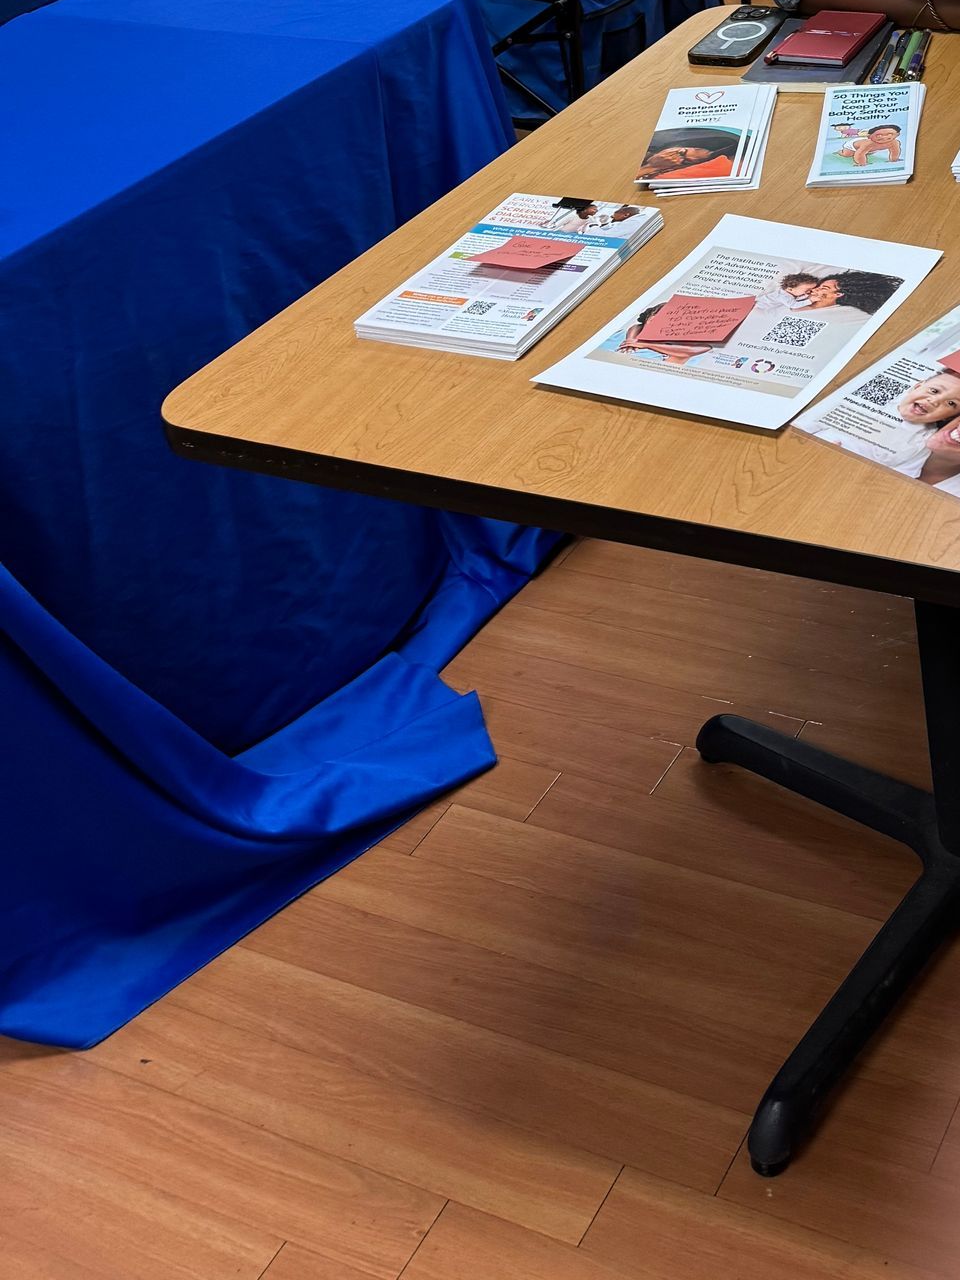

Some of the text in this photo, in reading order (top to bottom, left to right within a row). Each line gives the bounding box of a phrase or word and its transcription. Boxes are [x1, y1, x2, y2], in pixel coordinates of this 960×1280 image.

[501, 206, 555, 215] SCREENING
[732, 257, 764, 266] Institute
[715, 267, 747, 277] Minority
[748, 272, 774, 280] Health
[724, 262, 780, 275] Advancement
[693, 275, 722, 284] Project
[699, 270, 763, 284] EmpowerMOMS
